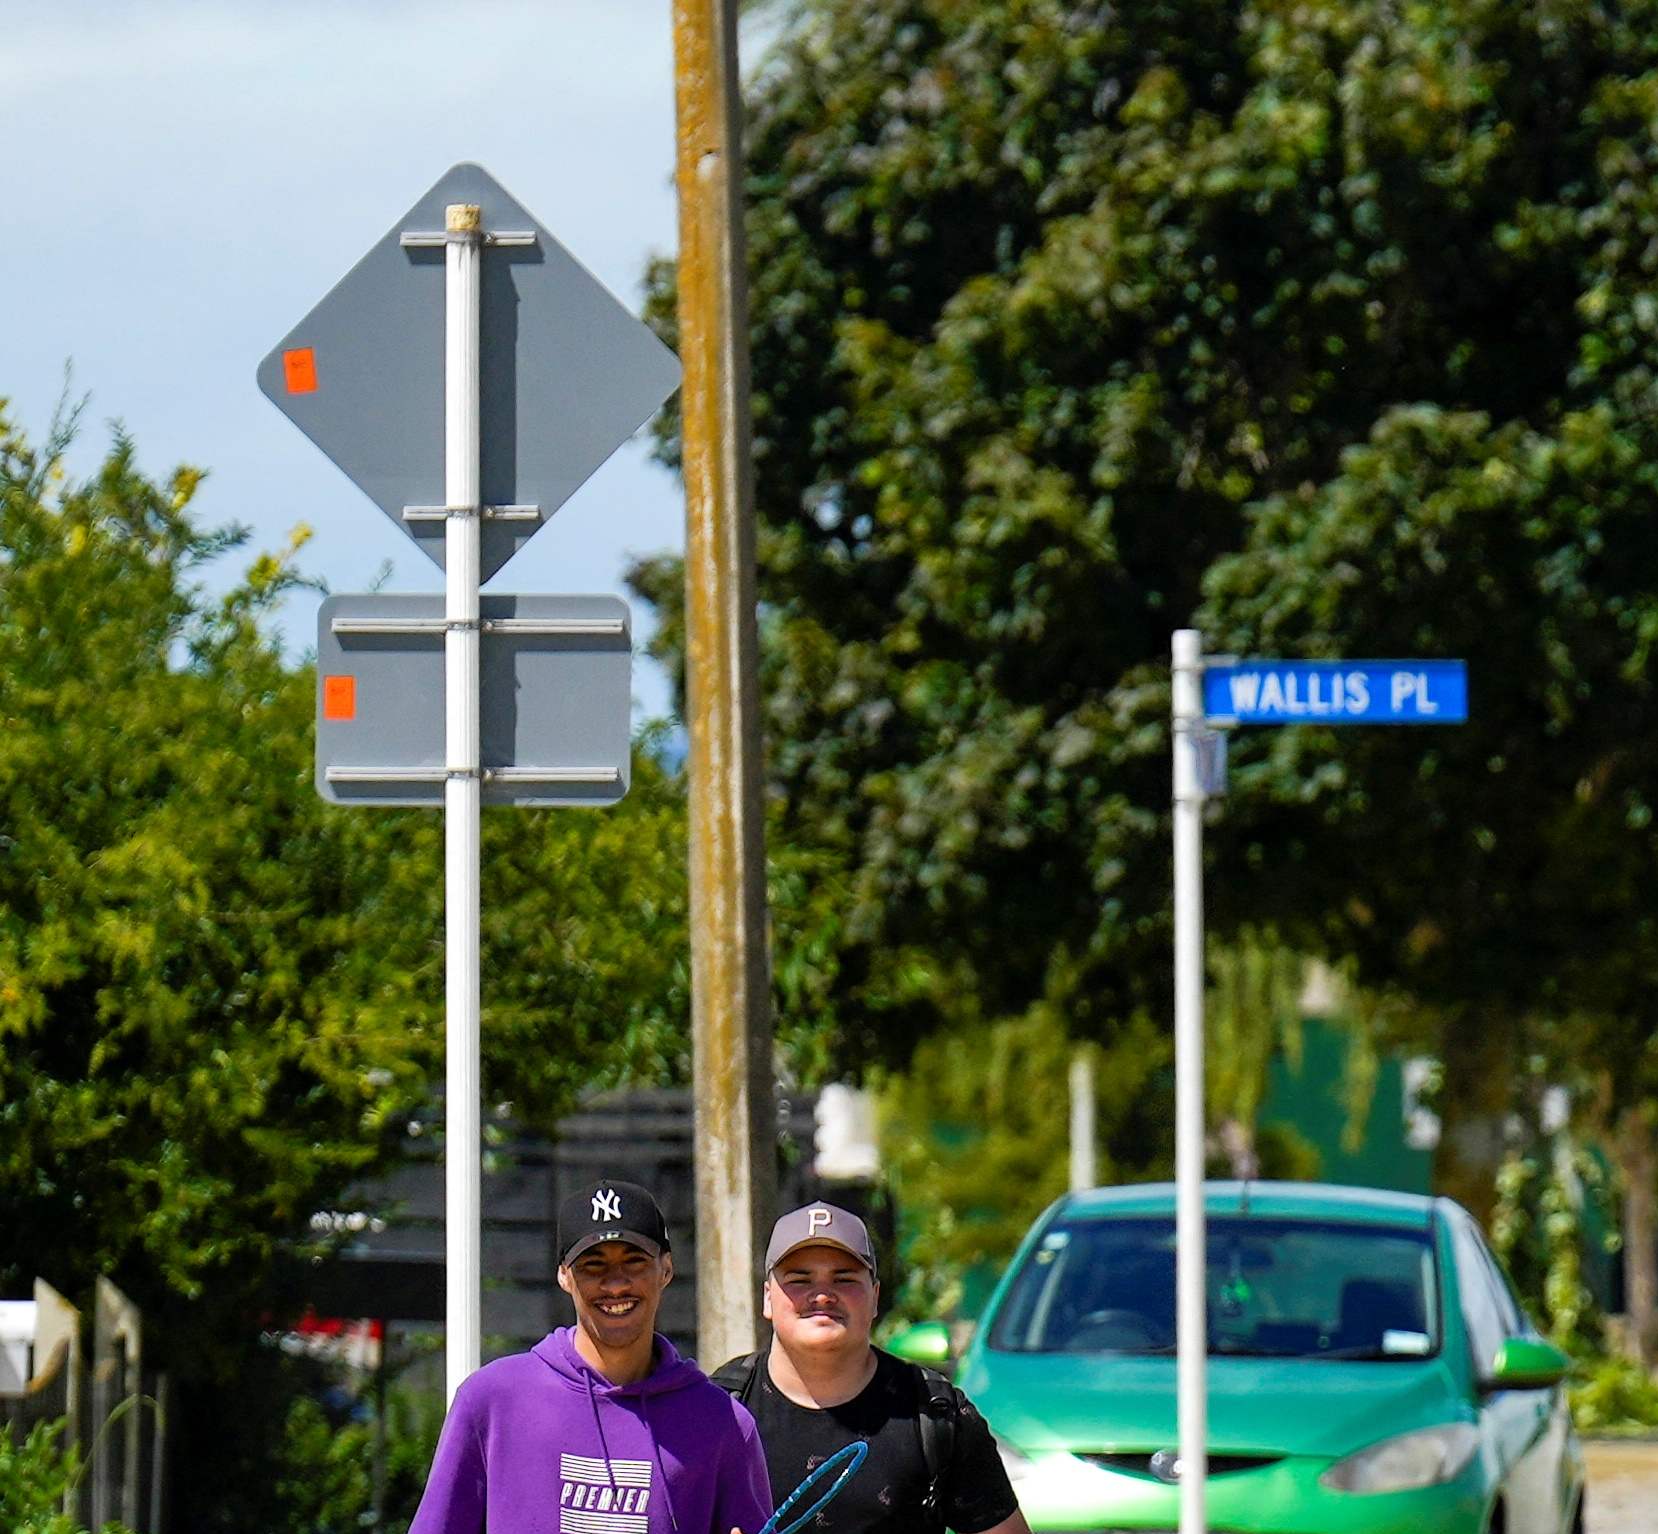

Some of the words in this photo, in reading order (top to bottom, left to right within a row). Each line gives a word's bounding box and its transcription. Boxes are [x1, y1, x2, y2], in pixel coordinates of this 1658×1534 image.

[1229, 671, 1370, 714] WALLIS
[1391, 671, 1439, 714] PL
[808, 1208, 832, 1237] P
